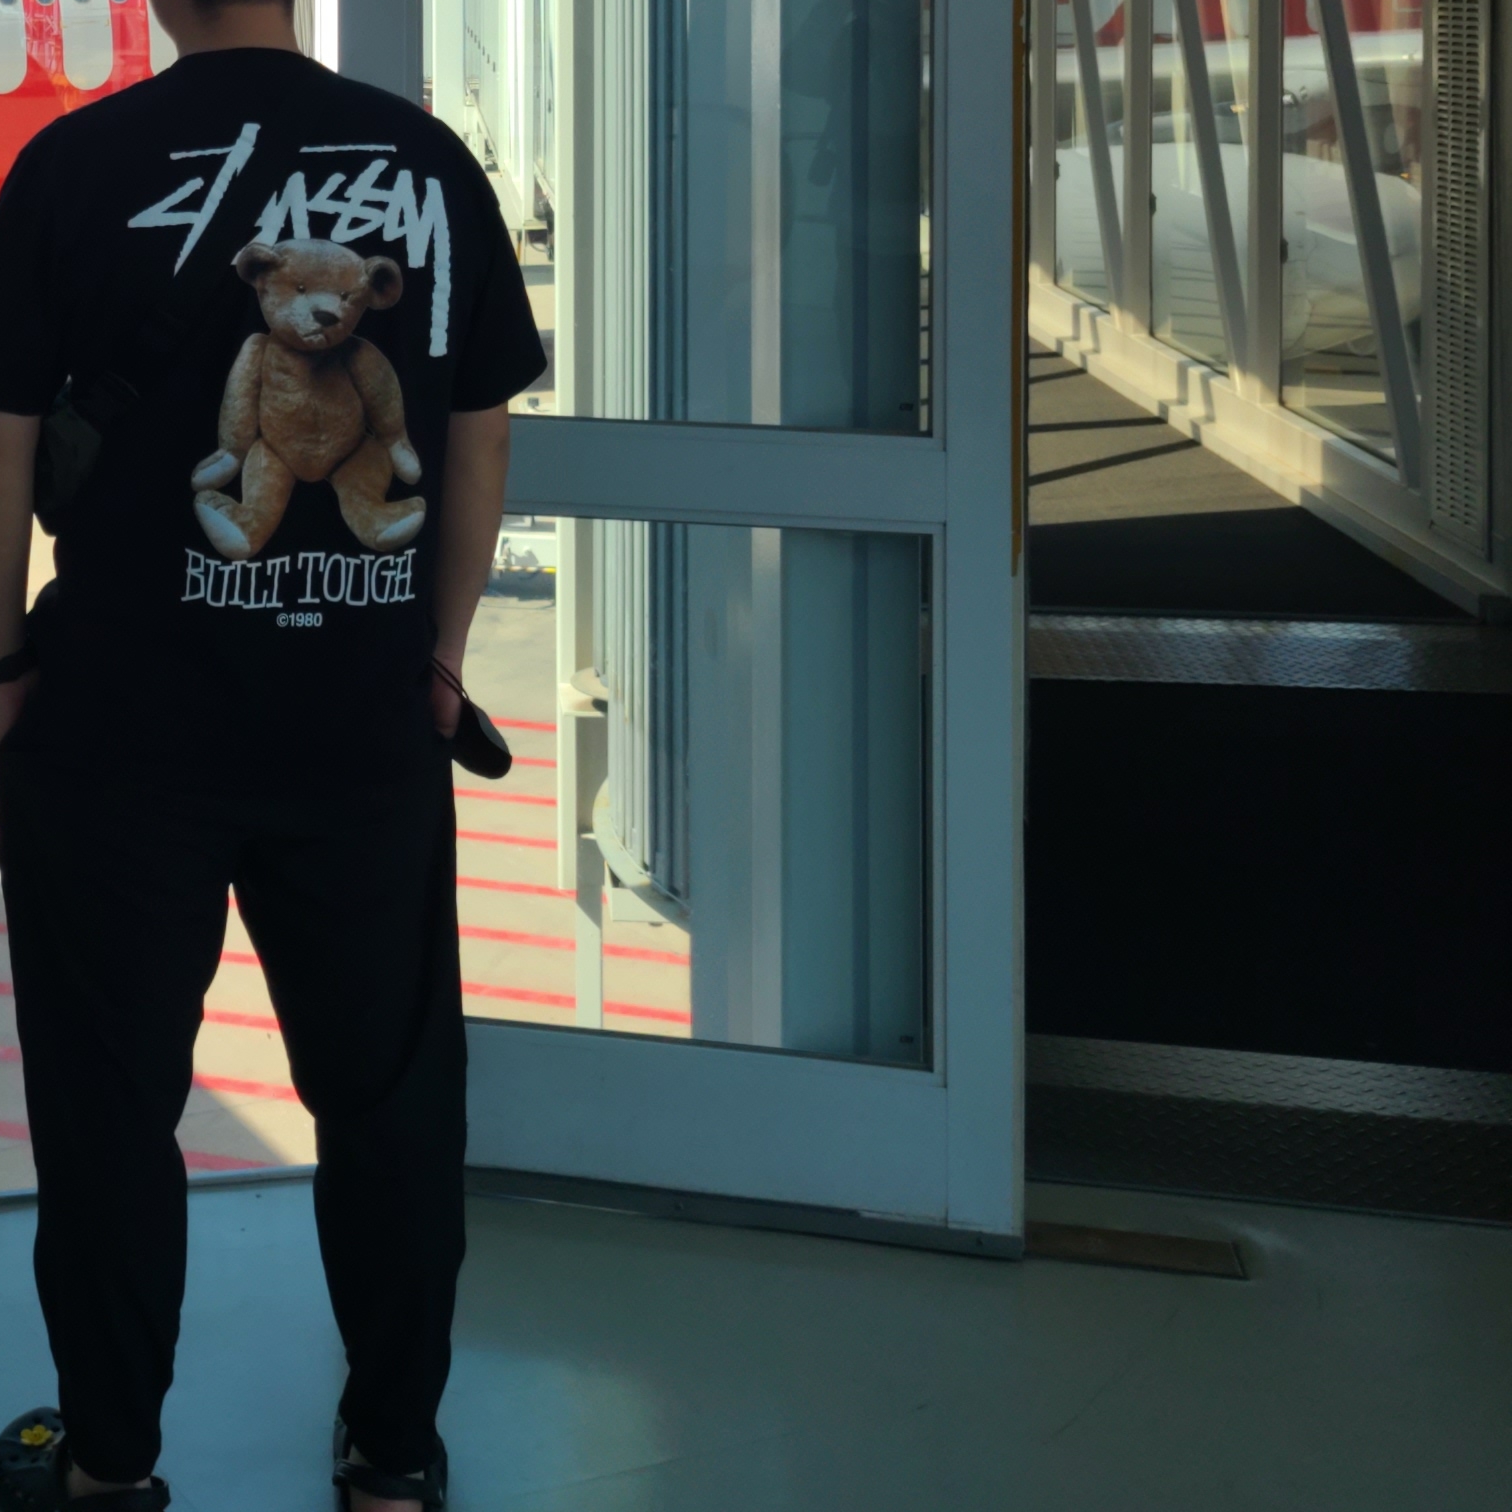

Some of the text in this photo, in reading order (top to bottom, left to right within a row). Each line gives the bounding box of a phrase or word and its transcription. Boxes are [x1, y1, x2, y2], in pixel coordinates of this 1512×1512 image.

[181, 548, 416, 609] BUILT TOUGH
[276, 612, 323, 628] ©1980
